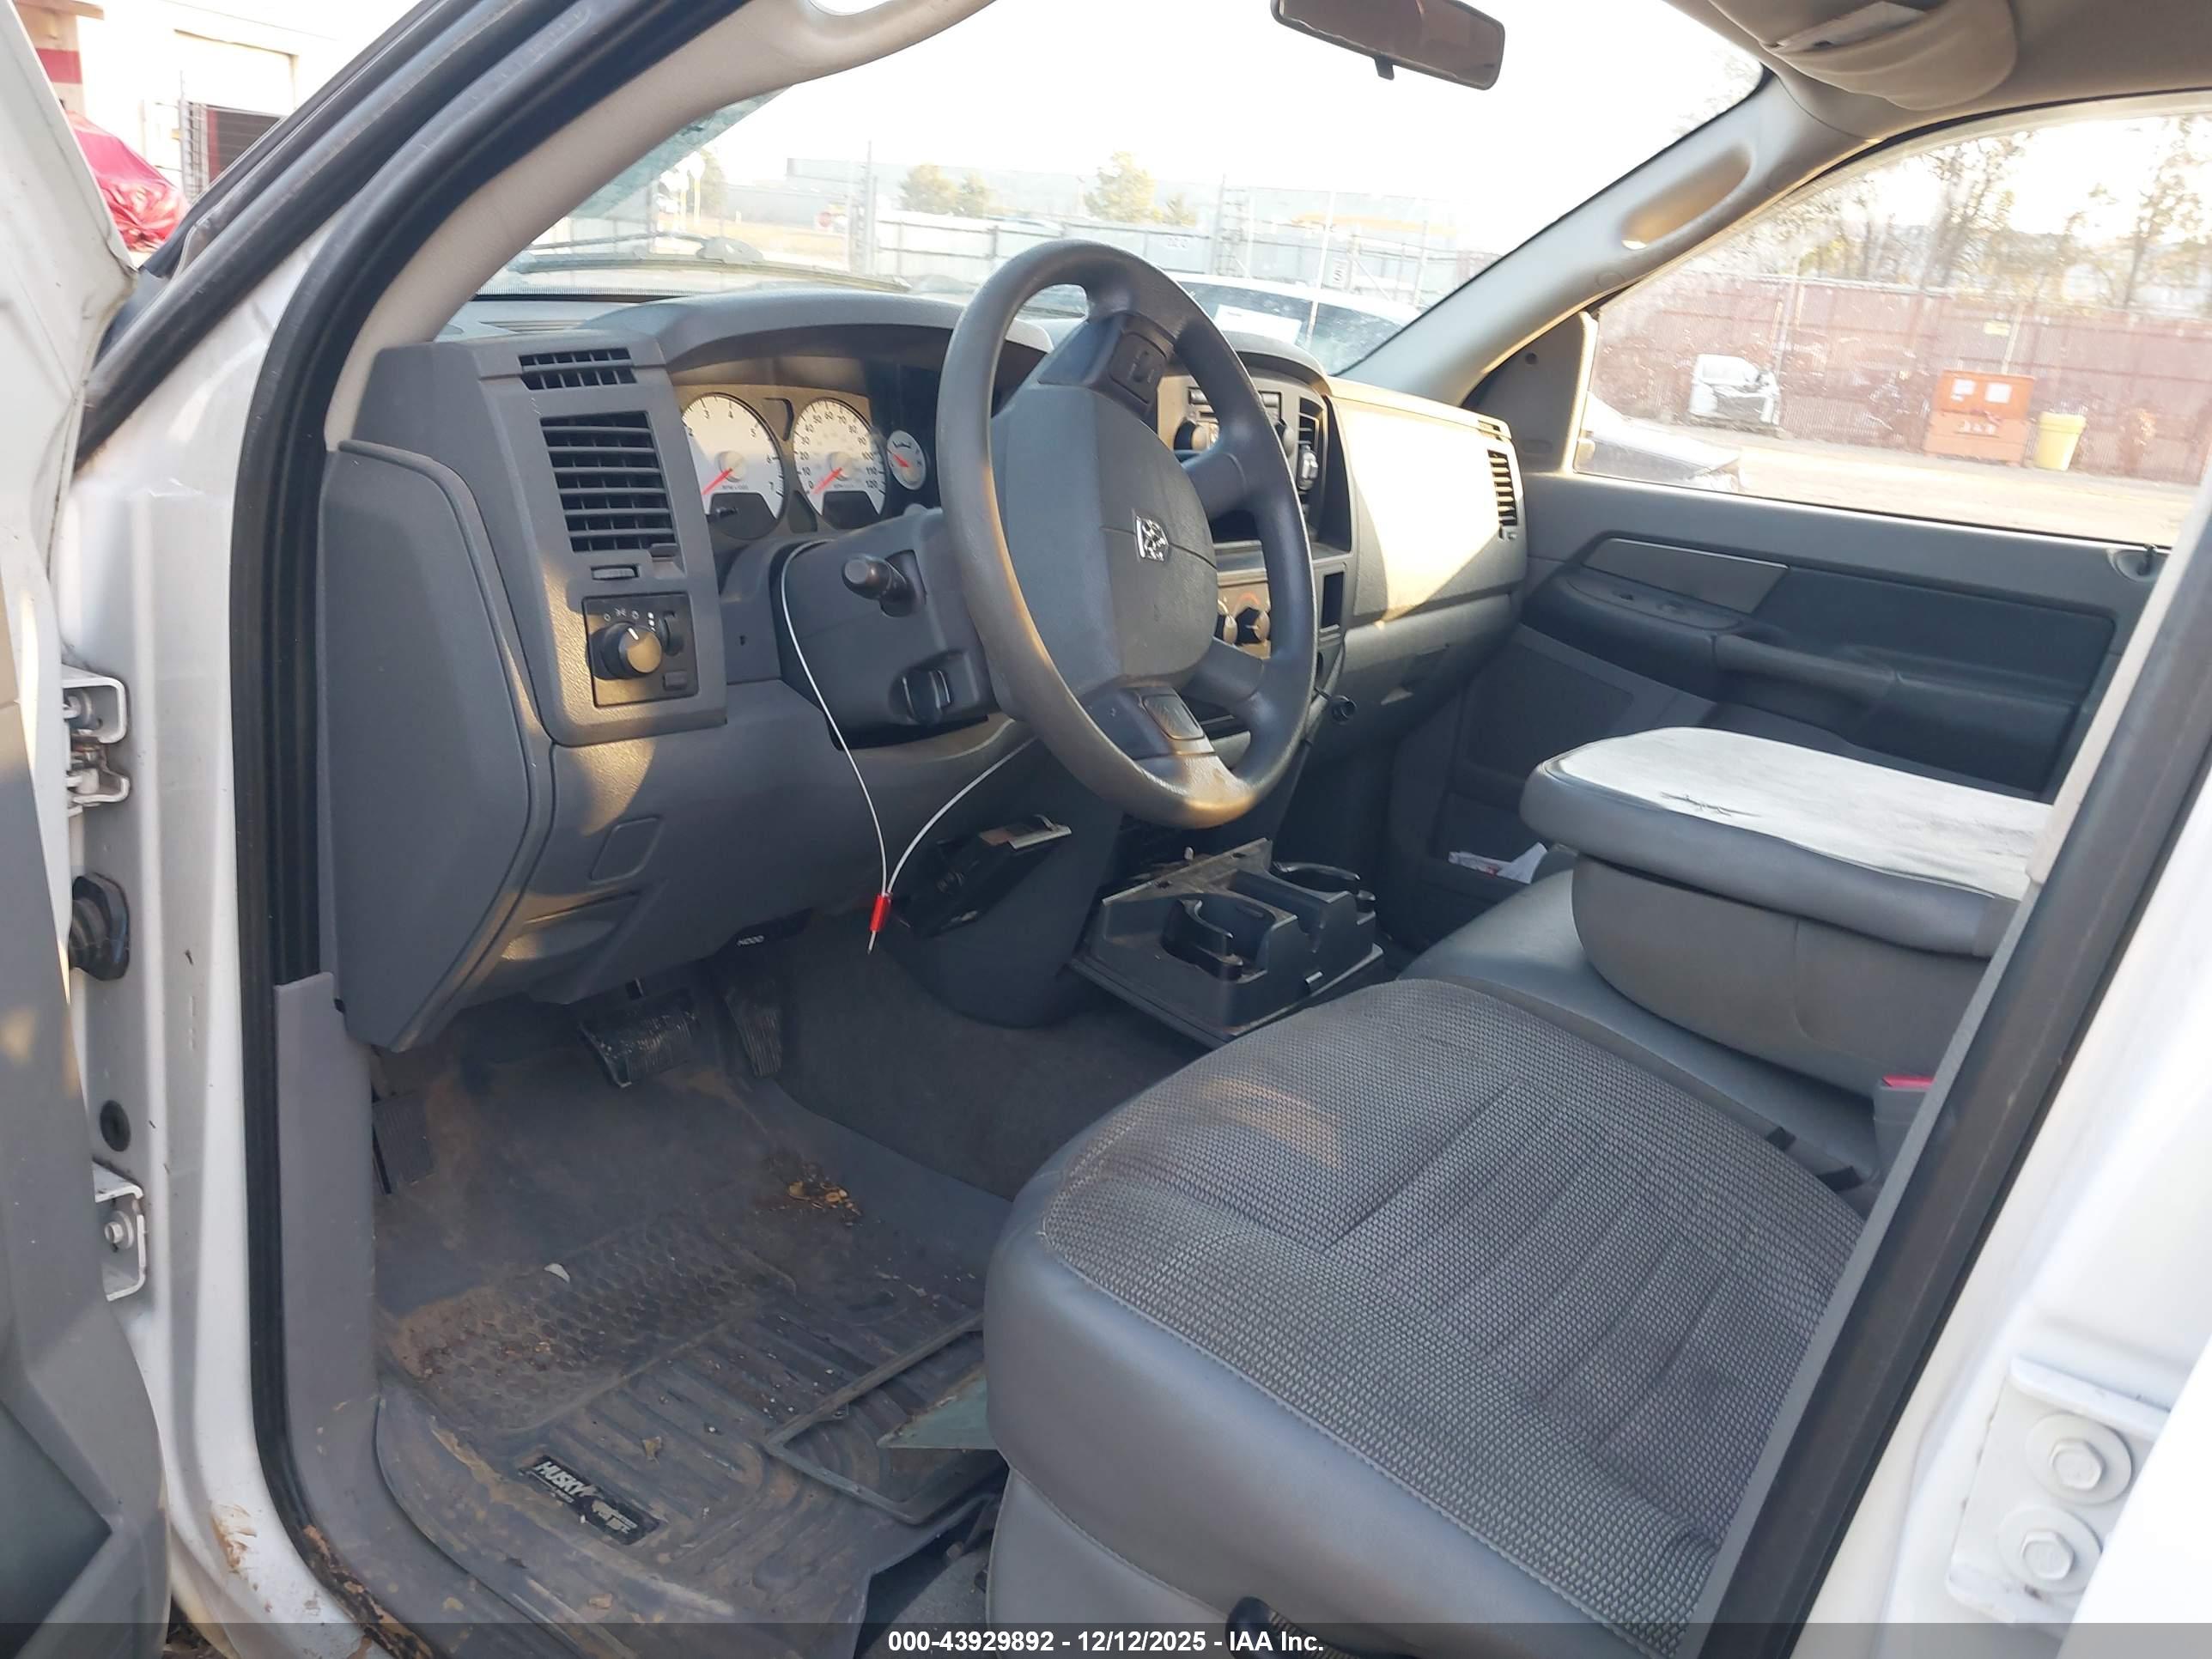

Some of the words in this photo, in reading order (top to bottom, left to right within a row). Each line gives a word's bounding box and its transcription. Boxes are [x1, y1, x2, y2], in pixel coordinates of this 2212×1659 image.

[703, 410, 710, 419] 3
[727, 410, 733, 419] 4
[837, 415, 847, 425] 70
[688, 427, 694, 437] 2
[750, 428, 757, 438] 5
[766, 453, 773, 464] 6
[799, 451, 810, 461] 20
[861, 452, 875, 462] 100
[802, 466, 811, 477] 10
[866, 466, 878, 477] 110
[769, 481, 775, 491] 7
[808, 480, 815, 489] 0
[866, 480, 878, 489] 120
[533, 1461, 587, 1496] HUSKY
